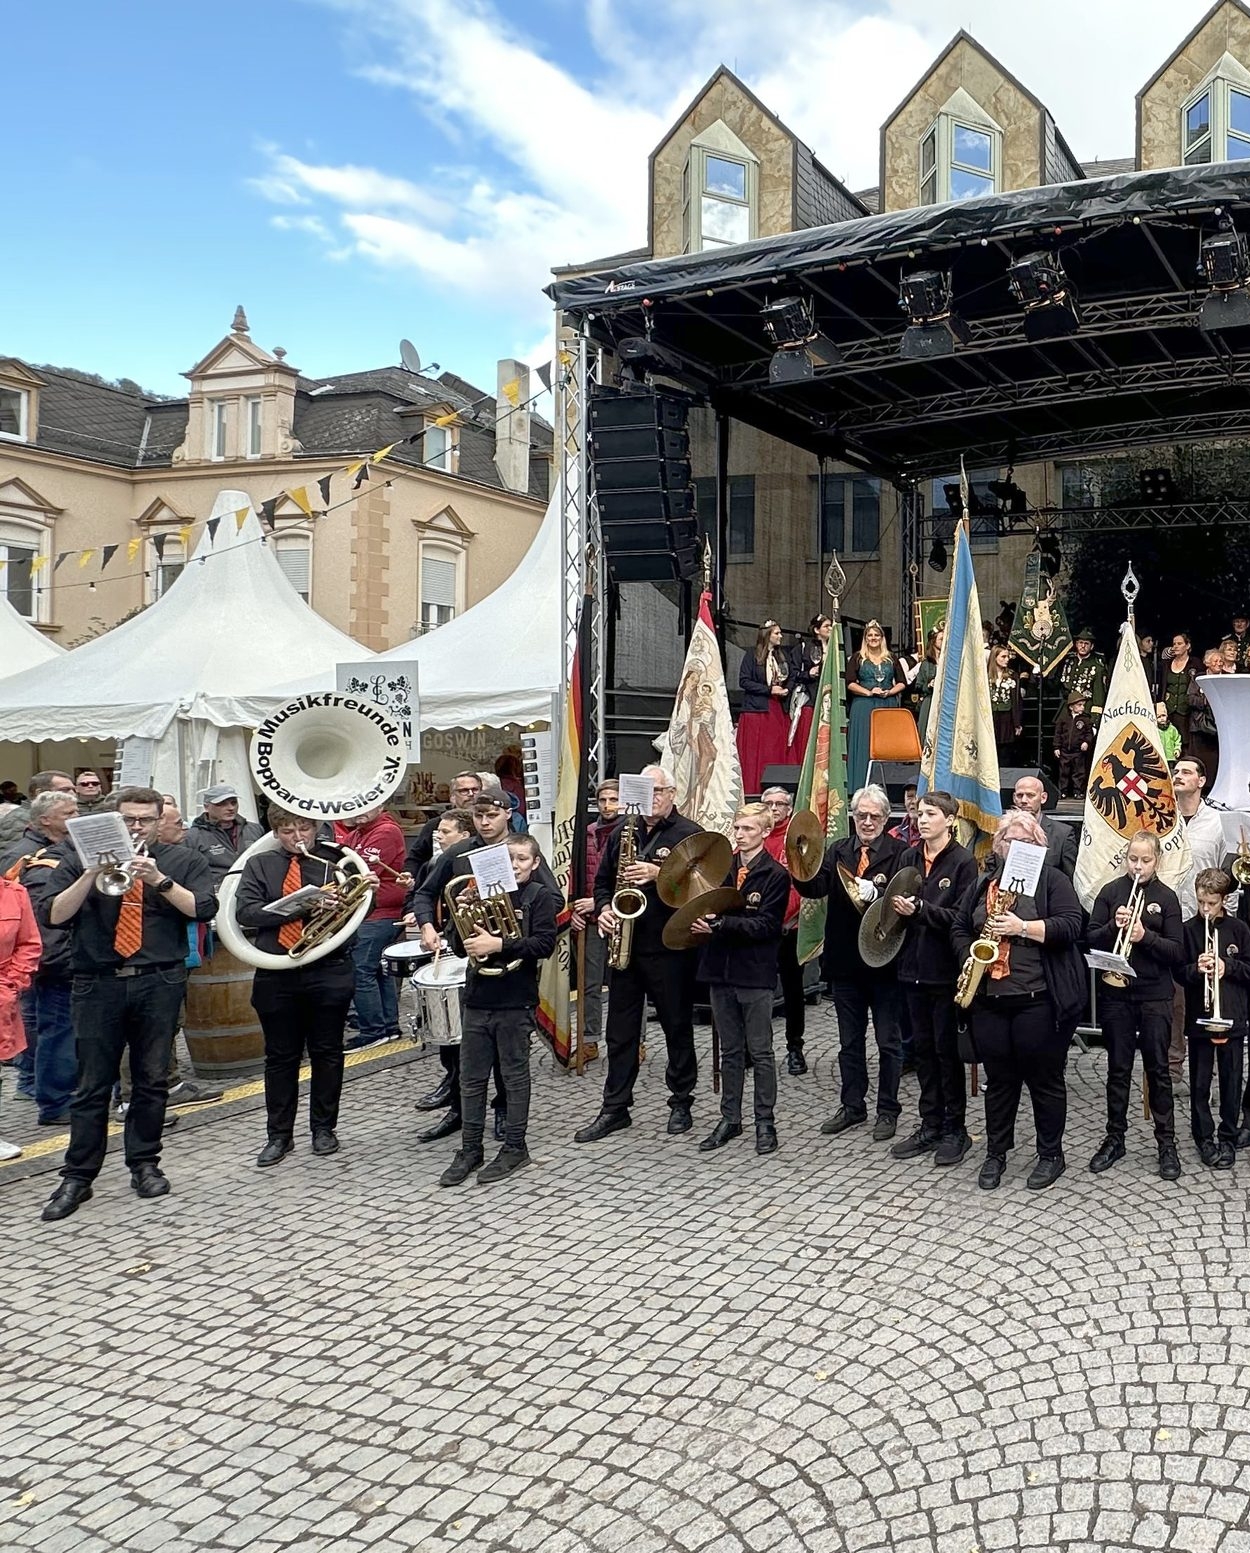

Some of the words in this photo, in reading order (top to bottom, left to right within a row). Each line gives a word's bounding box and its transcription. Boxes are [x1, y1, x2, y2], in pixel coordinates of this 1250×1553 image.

[257, 692, 400, 747] Musikfreunde
[423, 731, 487, 750] GOSWIN
[256, 741, 385, 814] Boppard-Weiler
[382, 755, 401, 785] e.V.
